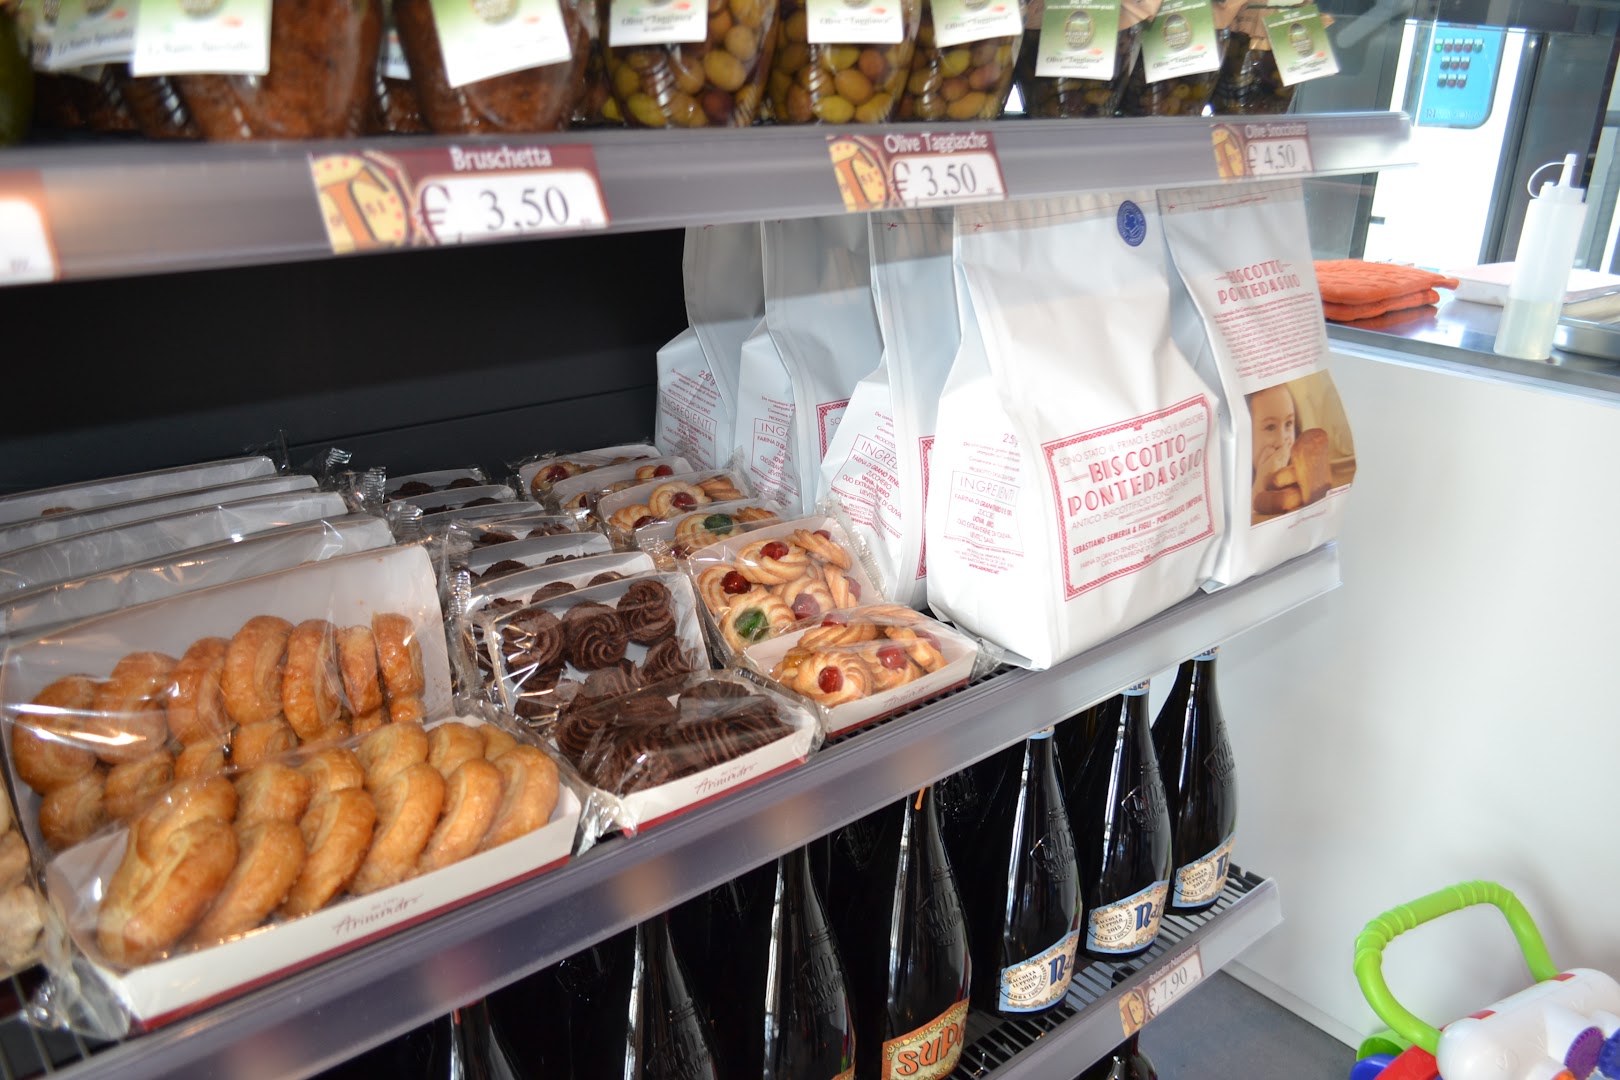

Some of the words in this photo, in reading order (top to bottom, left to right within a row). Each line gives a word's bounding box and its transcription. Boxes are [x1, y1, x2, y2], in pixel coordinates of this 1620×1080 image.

[450, 145, 552, 171] Bruschetta
[883, 133, 921, 154] Olive
[921, 131, 989, 156] Taggiasche
[480, 186, 569, 231] 3,50
[662, 397, 712, 431] INGREDIENTI
[1058, 453, 1083, 468] SONO
[1084, 446, 1107, 461] STATO
[1117, 436, 1143, 449] PRIMO
[1151, 425, 1173, 441] SONO
[1088, 434, 1186, 484] BISCOTTO
[1067, 448, 1203, 517] PONTEDASSIO
[1071, 513, 1102, 529] ANTICO
[1073, 537, 1106, 556] SEBASTIANO
[1107, 528, 1131, 542] SEMERIA
[1106, 925, 1122, 934] 2015
[1020, 982, 1036, 993] 2015
[1160, 966, 1188, 1000] 7,90
